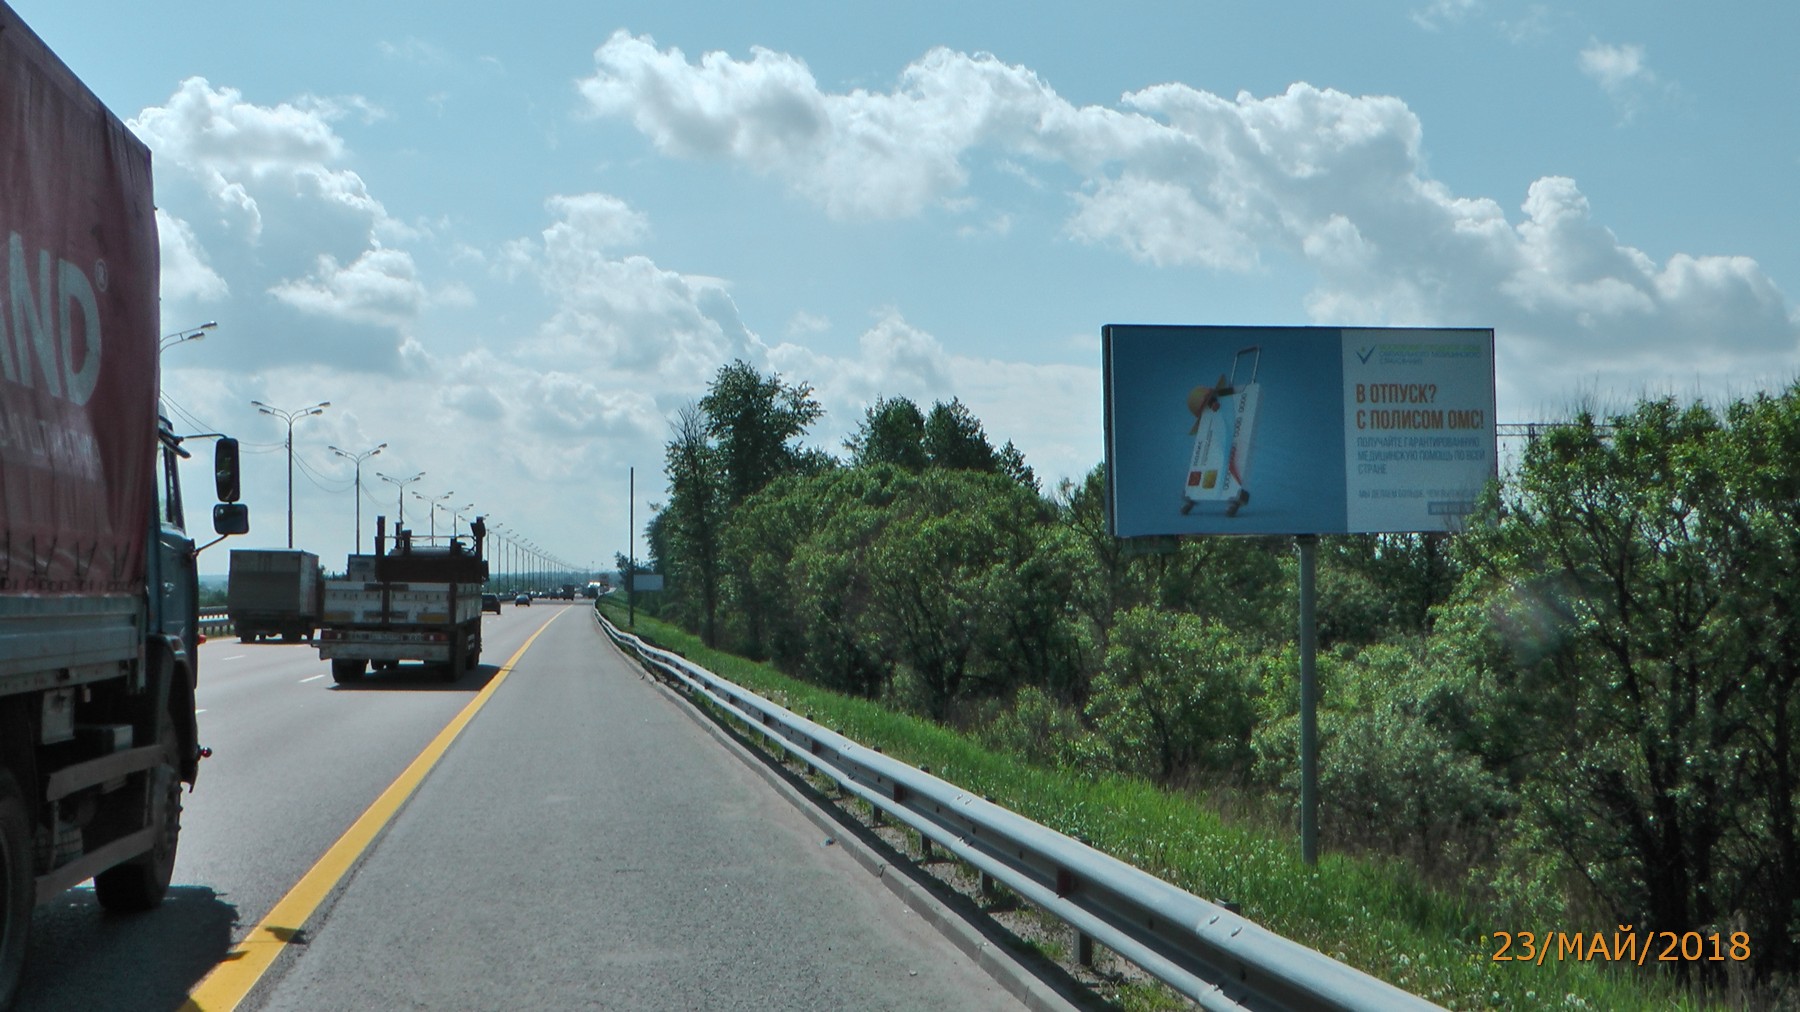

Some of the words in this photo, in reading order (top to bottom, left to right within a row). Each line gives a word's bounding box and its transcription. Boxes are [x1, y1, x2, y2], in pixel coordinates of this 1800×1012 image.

[1356, 383, 1366, 403] В
[1370, 383, 1437, 403] ОТПУСК?
[1357, 409, 1366, 430] С
[1370, 409, 1444, 429] ПОЛИСОМ
[1448, 409, 1484, 430] ОМС!
[1357, 436, 1402, 448] ПОЛУЧАЙТЕ
[1358, 450, 1418, 461] МЕДИЦИНСКУЮ
[1358, 463, 1387, 475] СТРАНЕ
